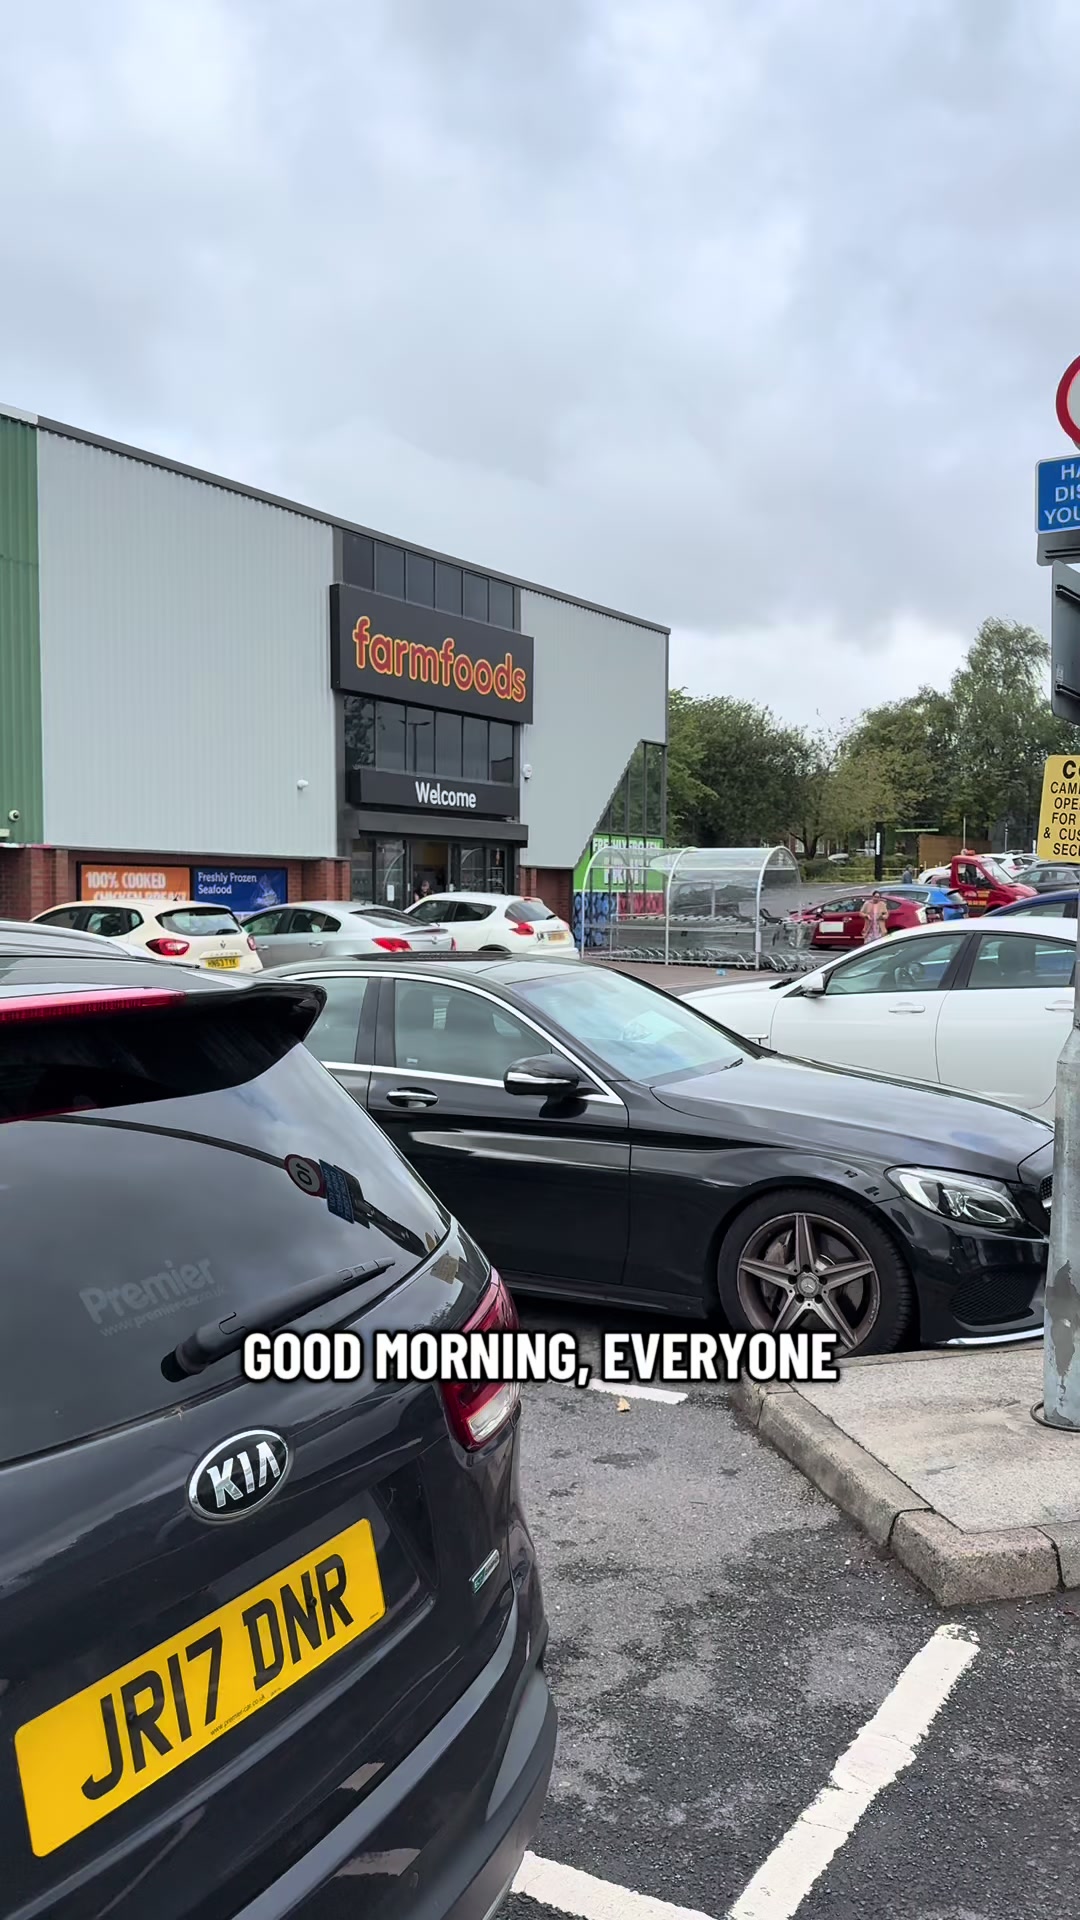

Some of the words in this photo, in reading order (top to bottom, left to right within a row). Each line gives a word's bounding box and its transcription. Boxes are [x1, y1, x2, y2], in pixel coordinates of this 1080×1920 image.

[352, 616, 526, 702] farmfoods
[1062, 760, 1080, 780] C
[415, 781, 477, 808] Welcome
[1050, 781, 1080, 795] CAM
[1054, 797, 1080, 810] OPE
[1051, 812, 1077, 826] FOR
[1043, 827, 1051, 839] &
[1053, 843, 1080, 857] SEC
[86, 871, 119, 889] 100%
[121, 872, 166, 889] COOKED
[198, 871, 229, 885] Freshly
[230, 872, 257, 883] Frozen
[198, 884, 233, 895] Seafood
[79, 1258, 215, 1325] Premier
[206, 1441, 281, 1509] KIA
[81, 1626, 223, 1801] JR17
[241, 1553, 355, 1692] DNR
